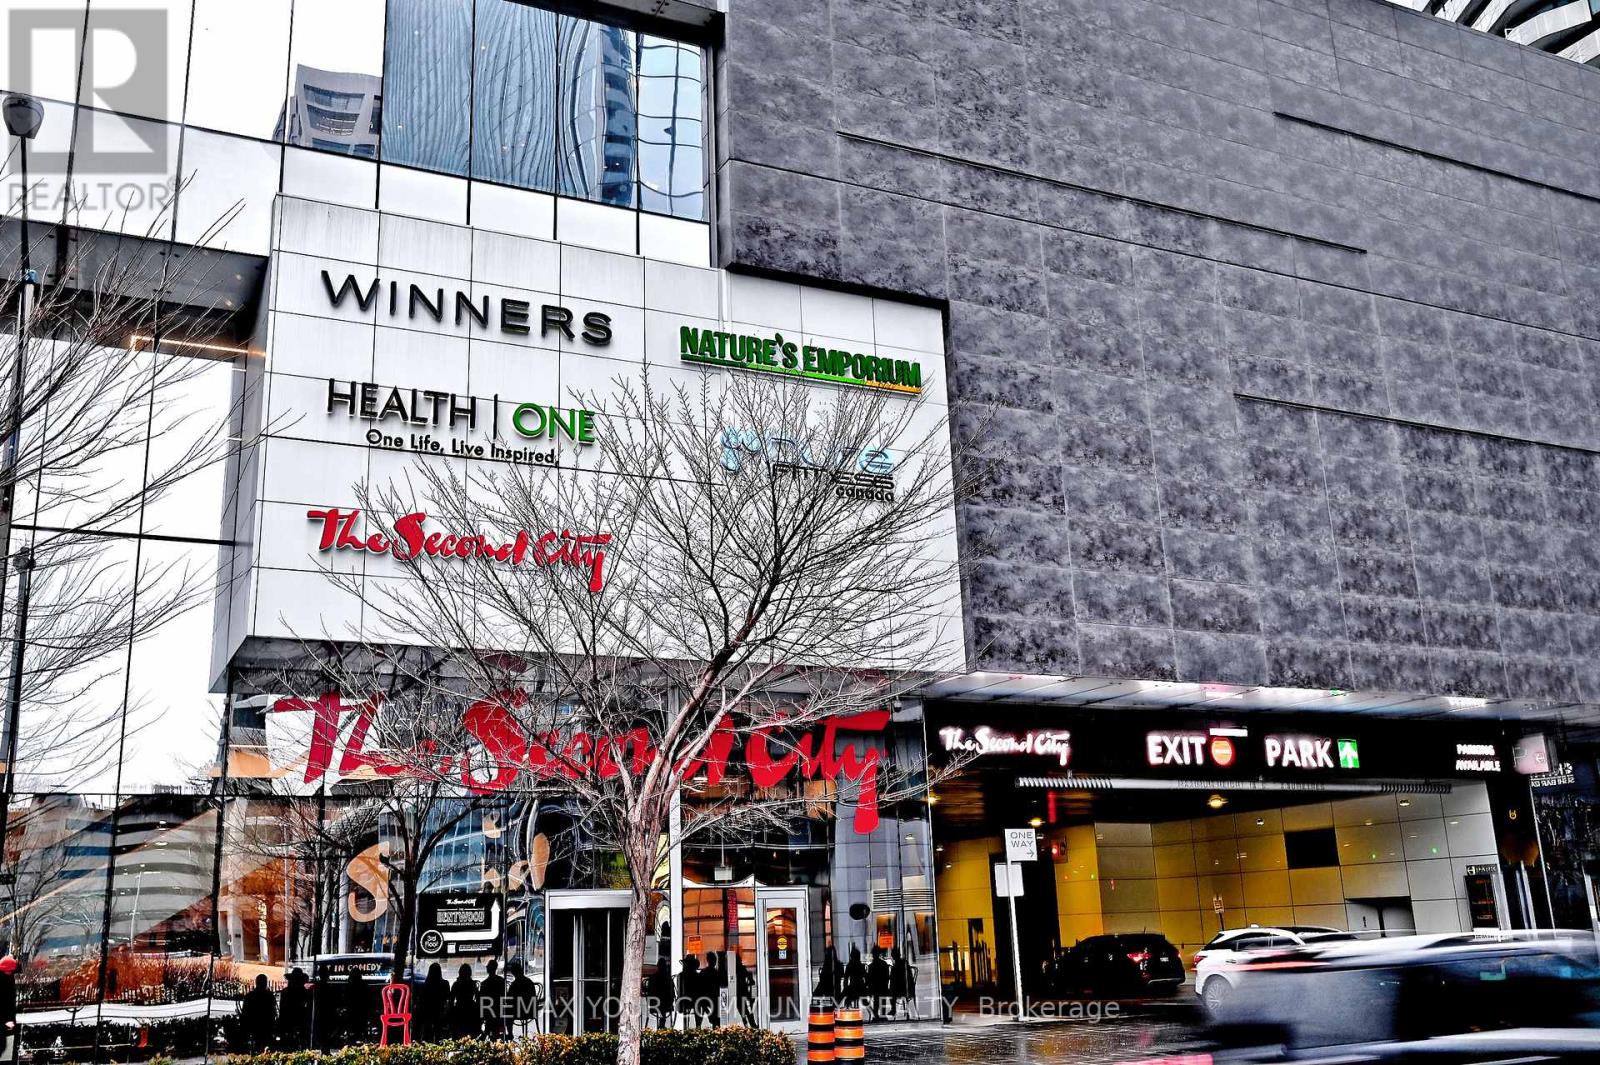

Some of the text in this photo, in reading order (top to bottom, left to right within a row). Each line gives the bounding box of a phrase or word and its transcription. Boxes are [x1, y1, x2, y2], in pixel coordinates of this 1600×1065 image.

[321, 270, 612, 346] WINNERS
[680, 326, 922, 388] NATURE'S EMPORIUM
[327, 378, 595, 445] HEALTH ONE
[366, 428, 404, 448] One
[452, 439, 485, 457] Live
[835, 486, 895, 502] canada
[307, 508, 613, 593] The Second City
[939, 725, 1071, 767] The Second City
[1147, 734, 1207, 765] EXIT
[1265, 738, 1335, 768] PARK
[745, 709, 891, 834] City
[1010, 831, 1033, 840] ONE
[1011, 840, 1034, 848] WAY
[334, 965, 344, 973] IN
